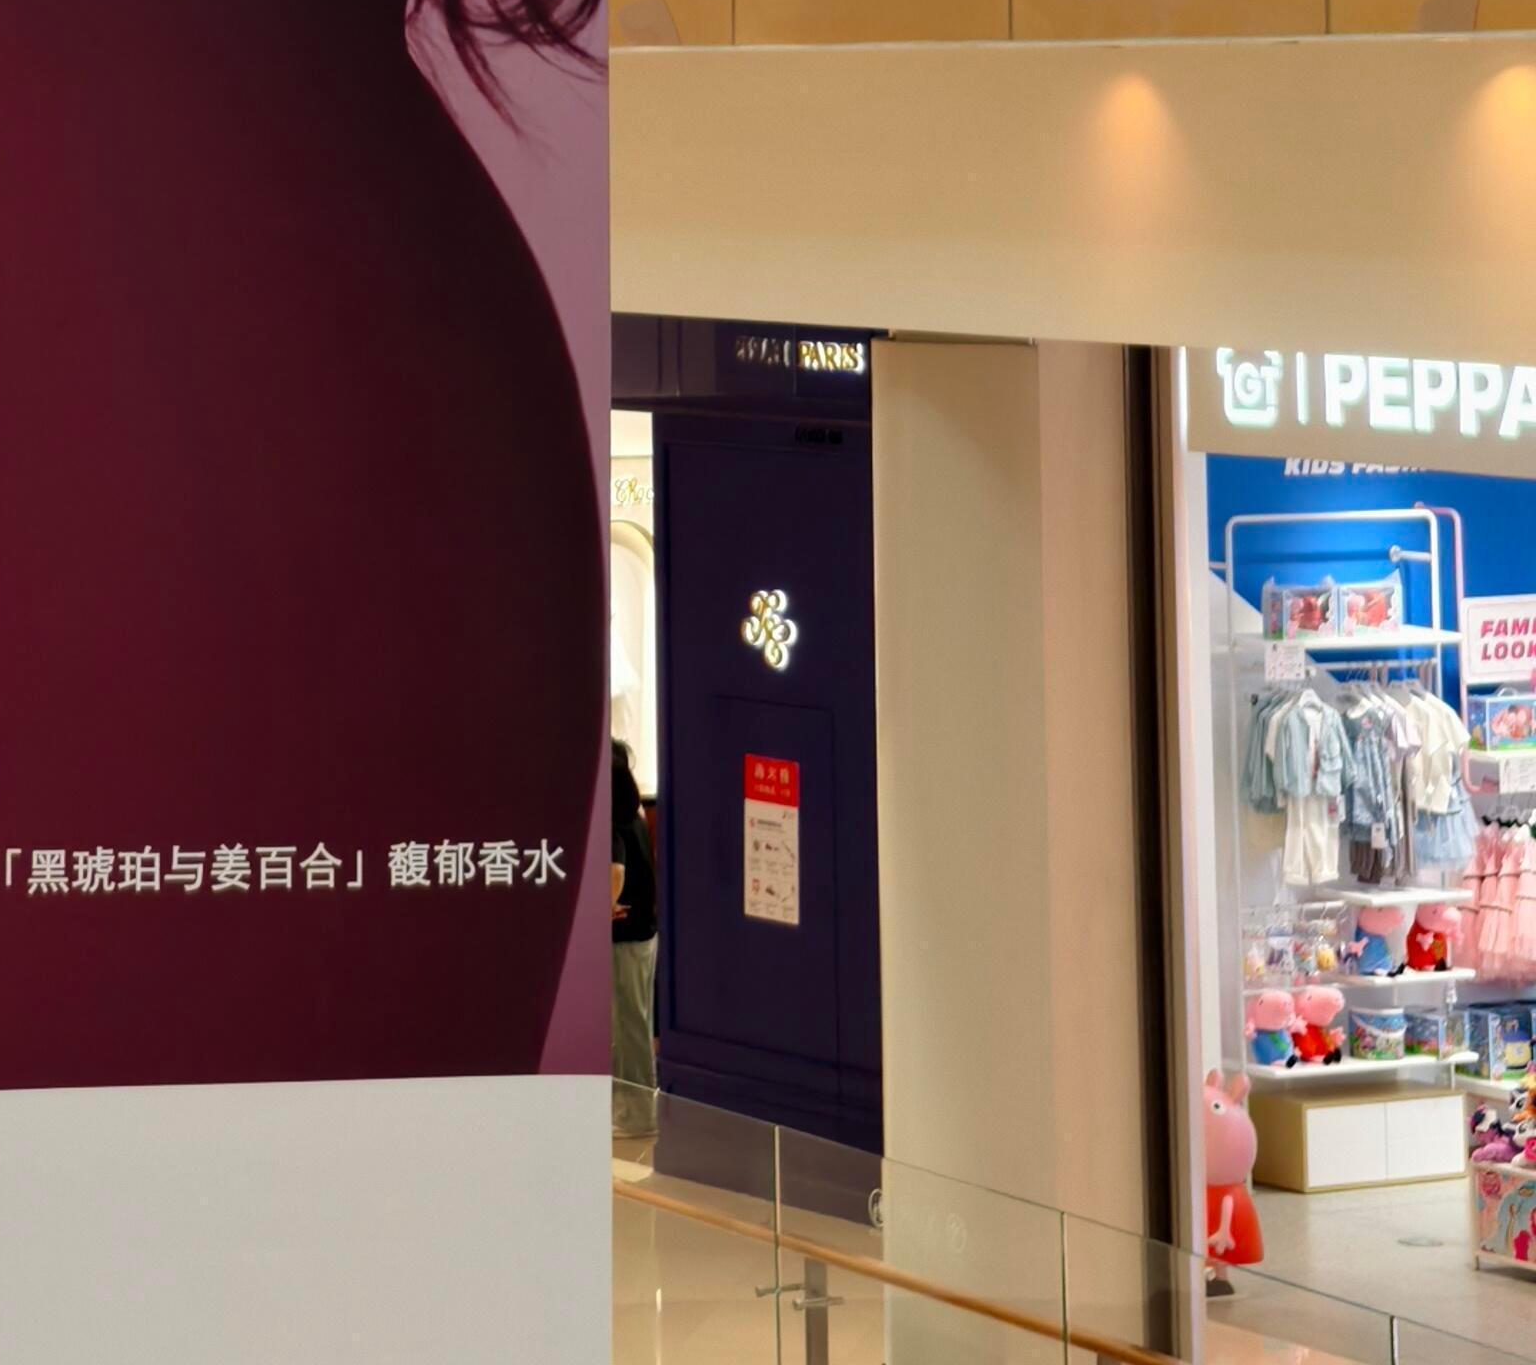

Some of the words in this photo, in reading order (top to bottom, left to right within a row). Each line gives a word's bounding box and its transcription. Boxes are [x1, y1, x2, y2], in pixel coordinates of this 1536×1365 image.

[1324, 354, 1536, 440] PEPPA
[5, 842, 364, 895] 「黑琥珀与姜百合」
[387, 838, 567, 887] 馥郁香水
